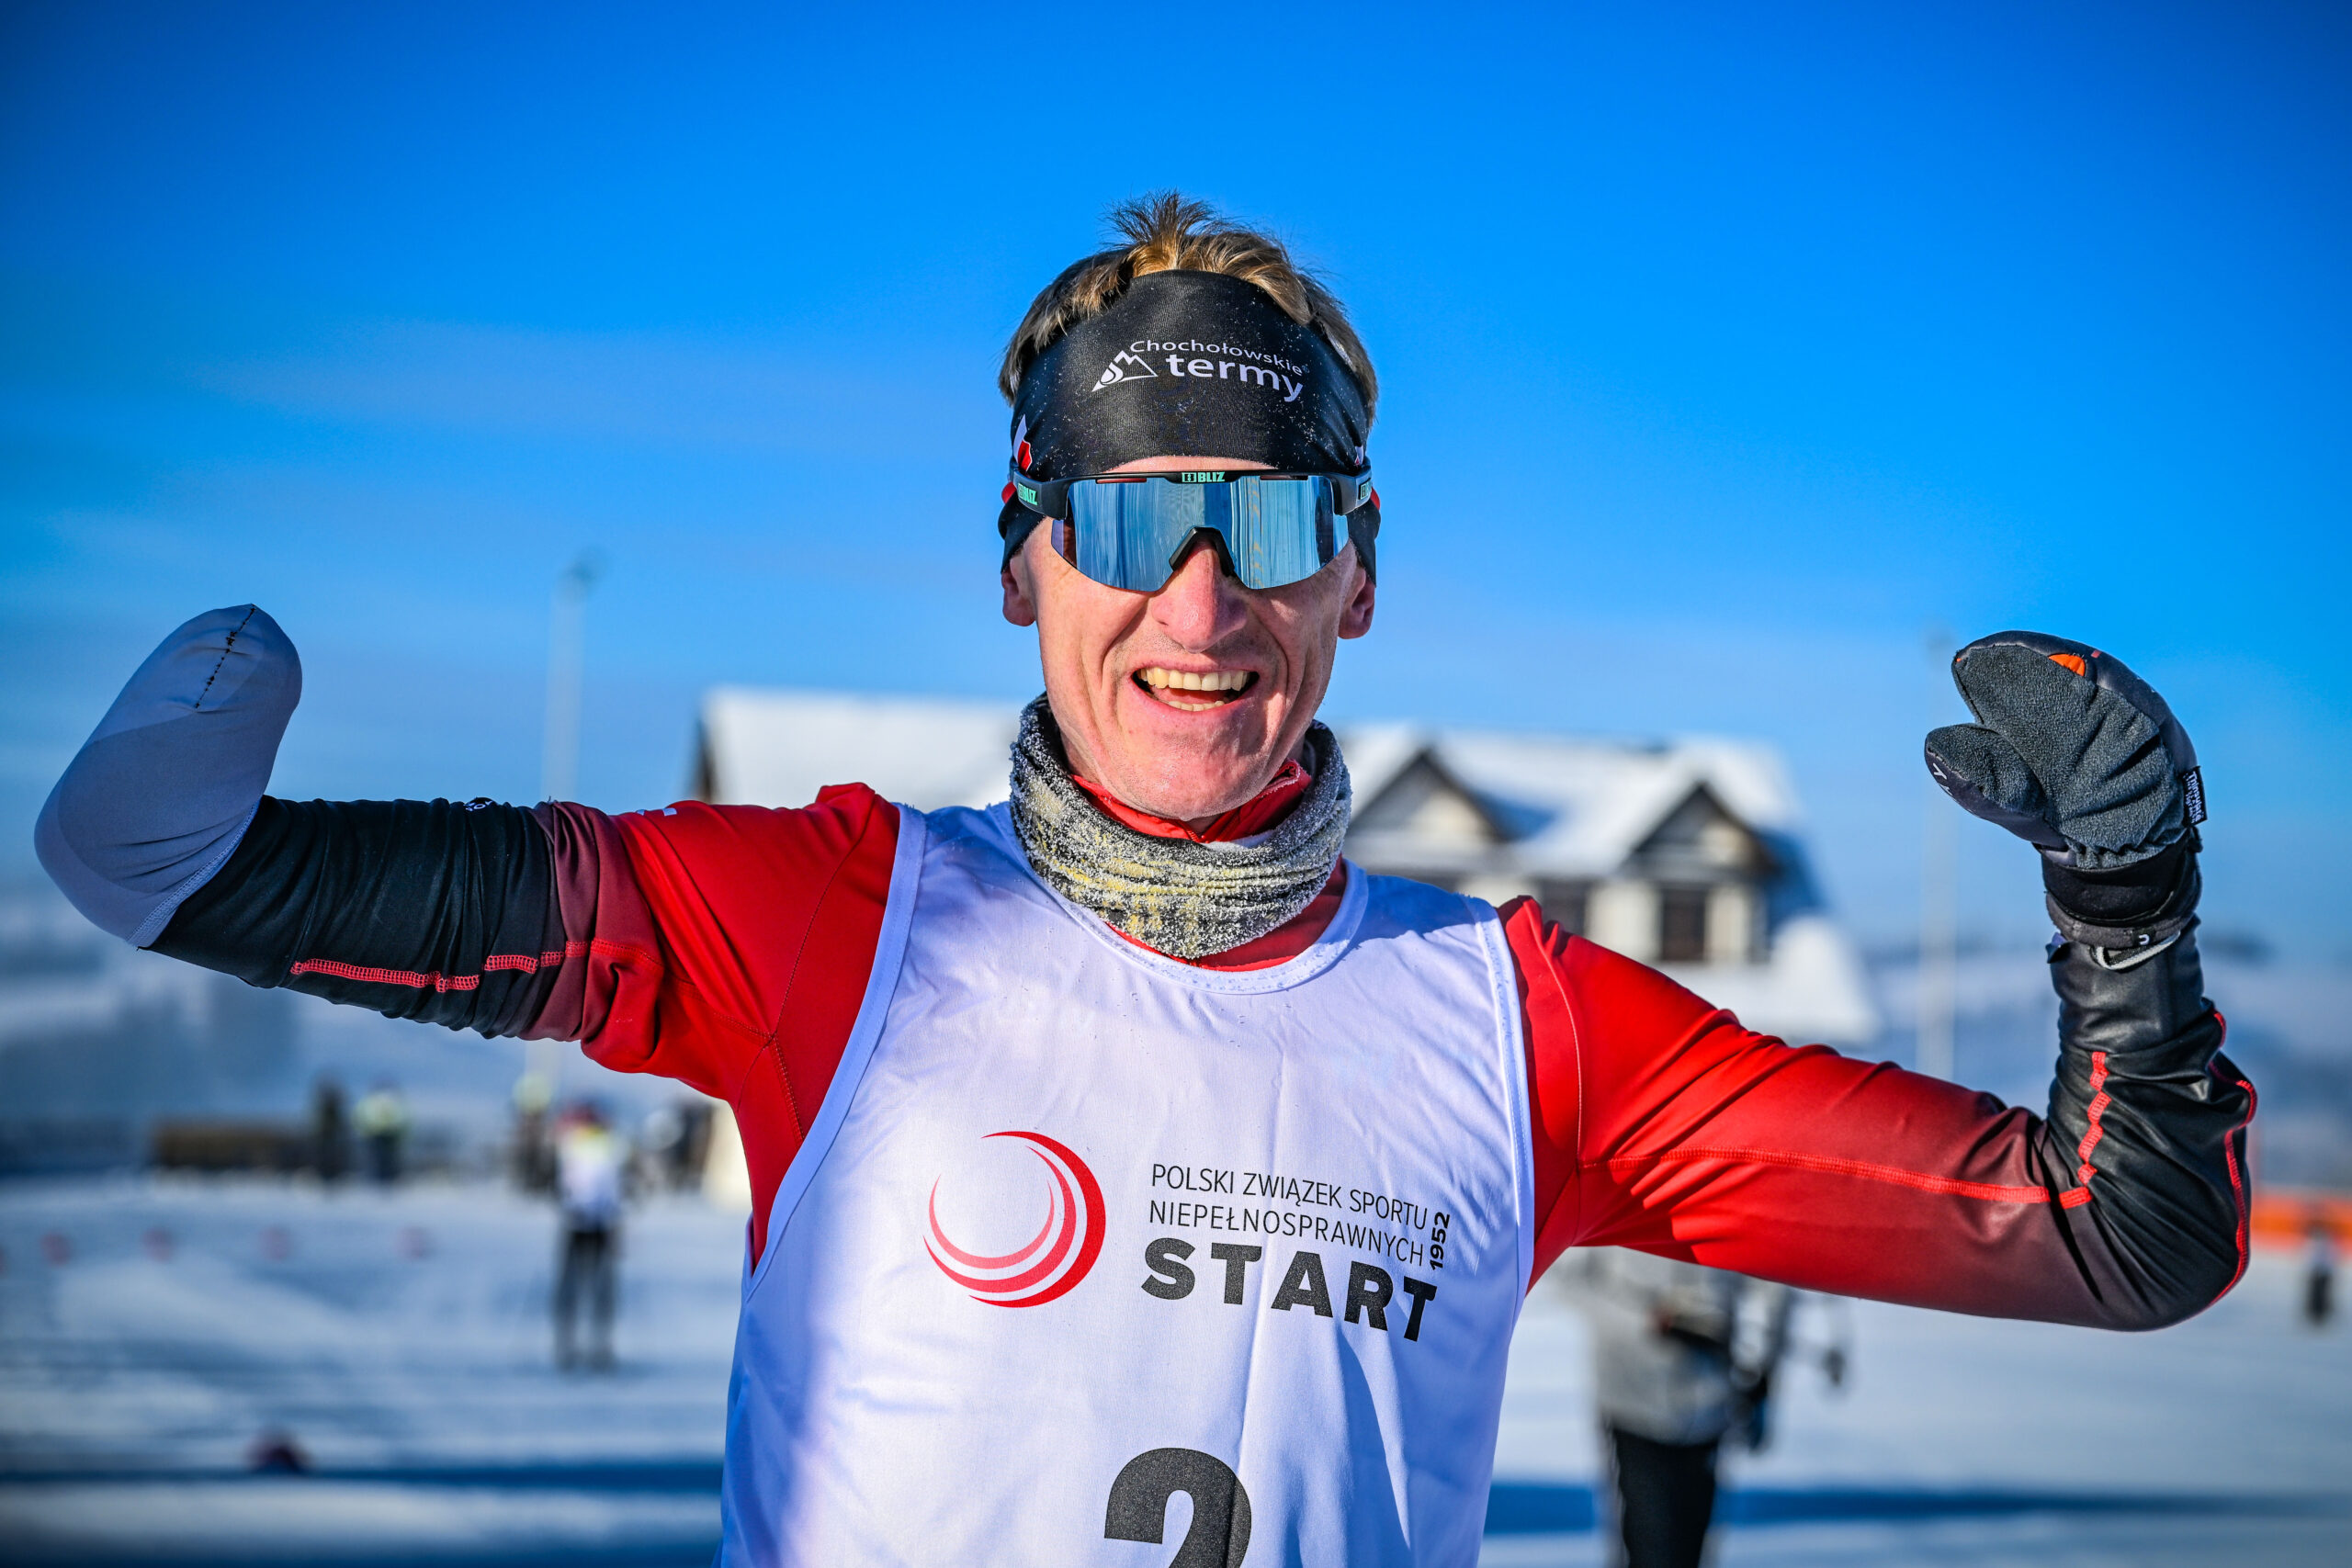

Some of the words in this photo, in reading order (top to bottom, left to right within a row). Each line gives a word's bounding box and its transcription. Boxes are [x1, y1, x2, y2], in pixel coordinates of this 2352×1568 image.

[1130, 340, 1302, 376] Chochołowskie
[1166, 355, 1303, 402] termy
[1198, 471, 1225, 482] BLIZ
[1152, 1164, 1234, 1193] POLSKI
[1243, 1173, 1341, 1207] ZWIĄZEK
[1350, 1190, 1427, 1230] SPORTU
[1150, 1200, 1423, 1267] NIEPEŁNOSPRAWNYCH
[1430, 1212, 1450, 1270] 1952
[1141, 1237, 1438, 1342] START
[1104, 1447, 1252, 1568] 2
